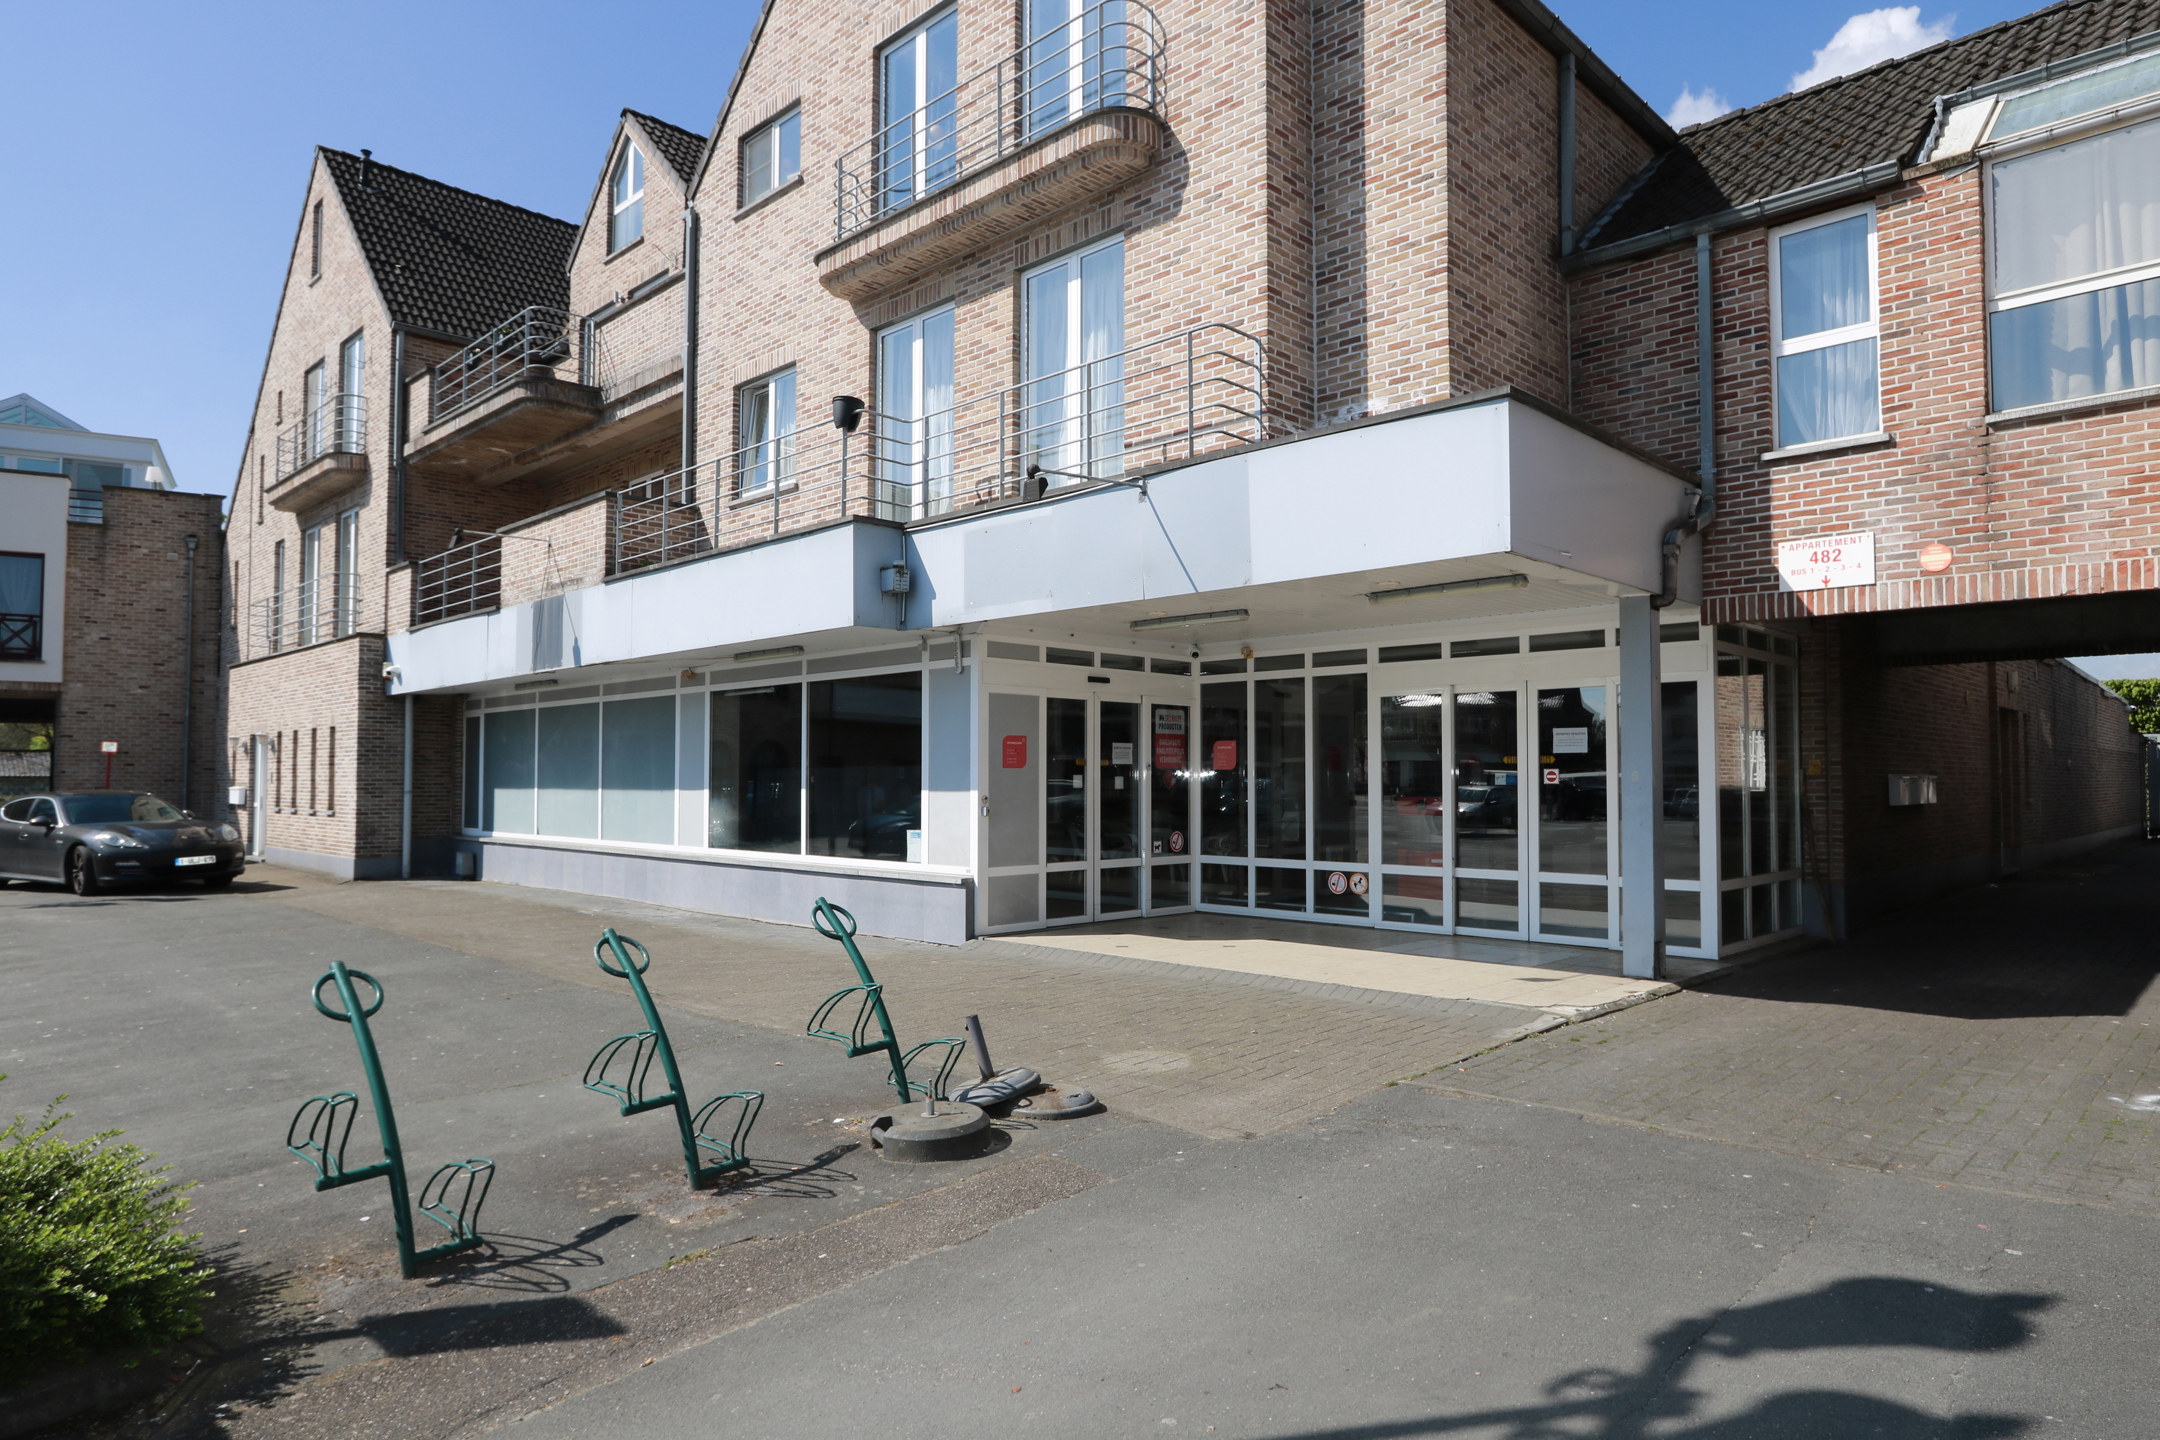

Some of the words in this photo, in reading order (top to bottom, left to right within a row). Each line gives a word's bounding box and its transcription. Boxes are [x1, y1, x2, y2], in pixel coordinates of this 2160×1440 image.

[1788, 536, 1863, 552] APPARTEMENT
[1809, 548, 1842, 564] 482
[1791, 568, 1807, 576] BUS
[1158, 722, 1183, 731] PRODUCTEN
